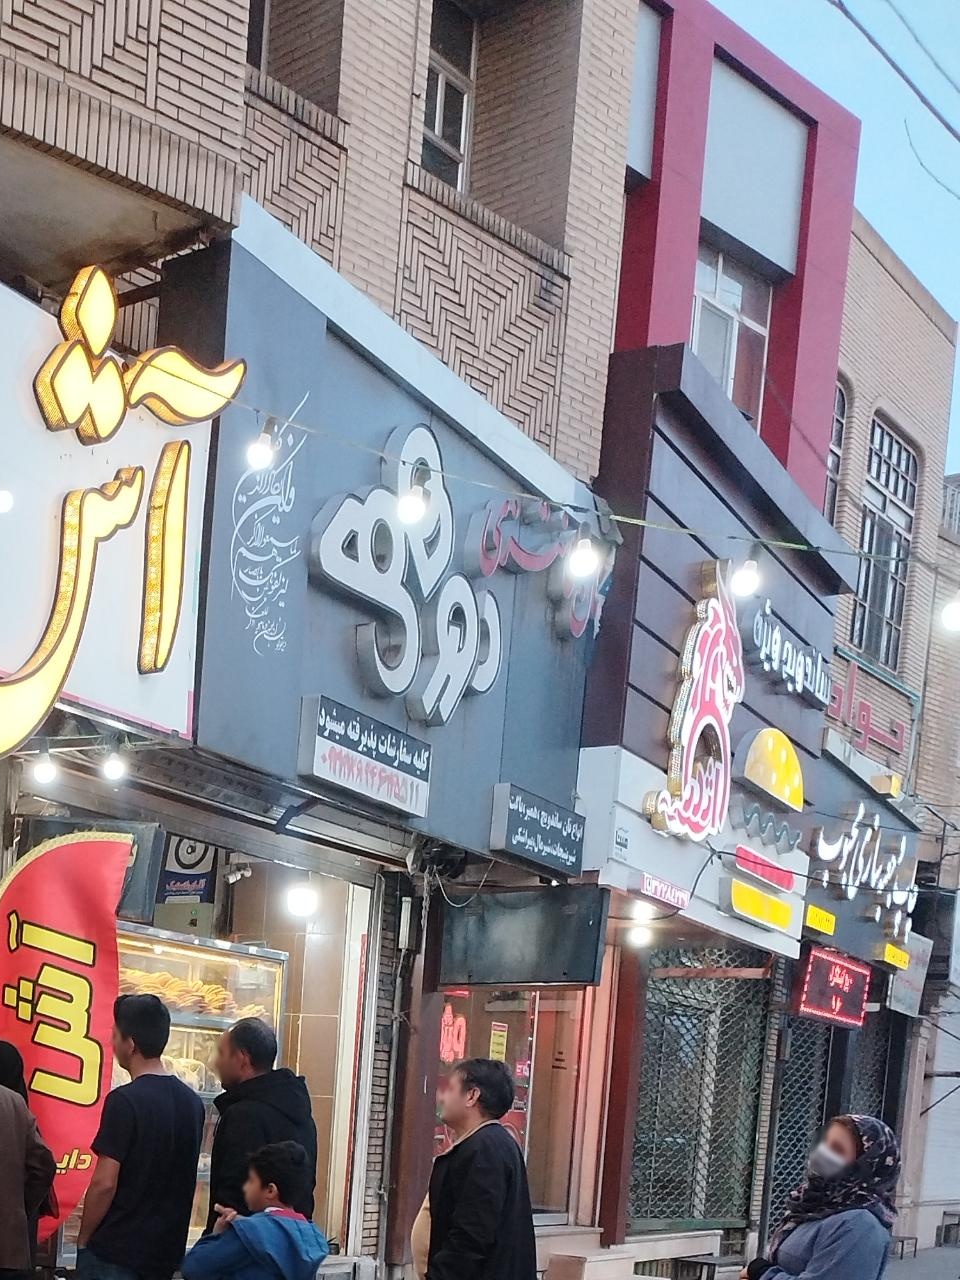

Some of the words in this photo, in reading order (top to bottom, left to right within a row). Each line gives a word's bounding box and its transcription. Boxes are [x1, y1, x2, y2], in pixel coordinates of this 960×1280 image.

[346, 716, 378, 758] پذیرفته
[378, 732, 412, 768] سفارشات
[413, 747, 430, 775] کلیه
[3, 909, 103, 1106] آش
